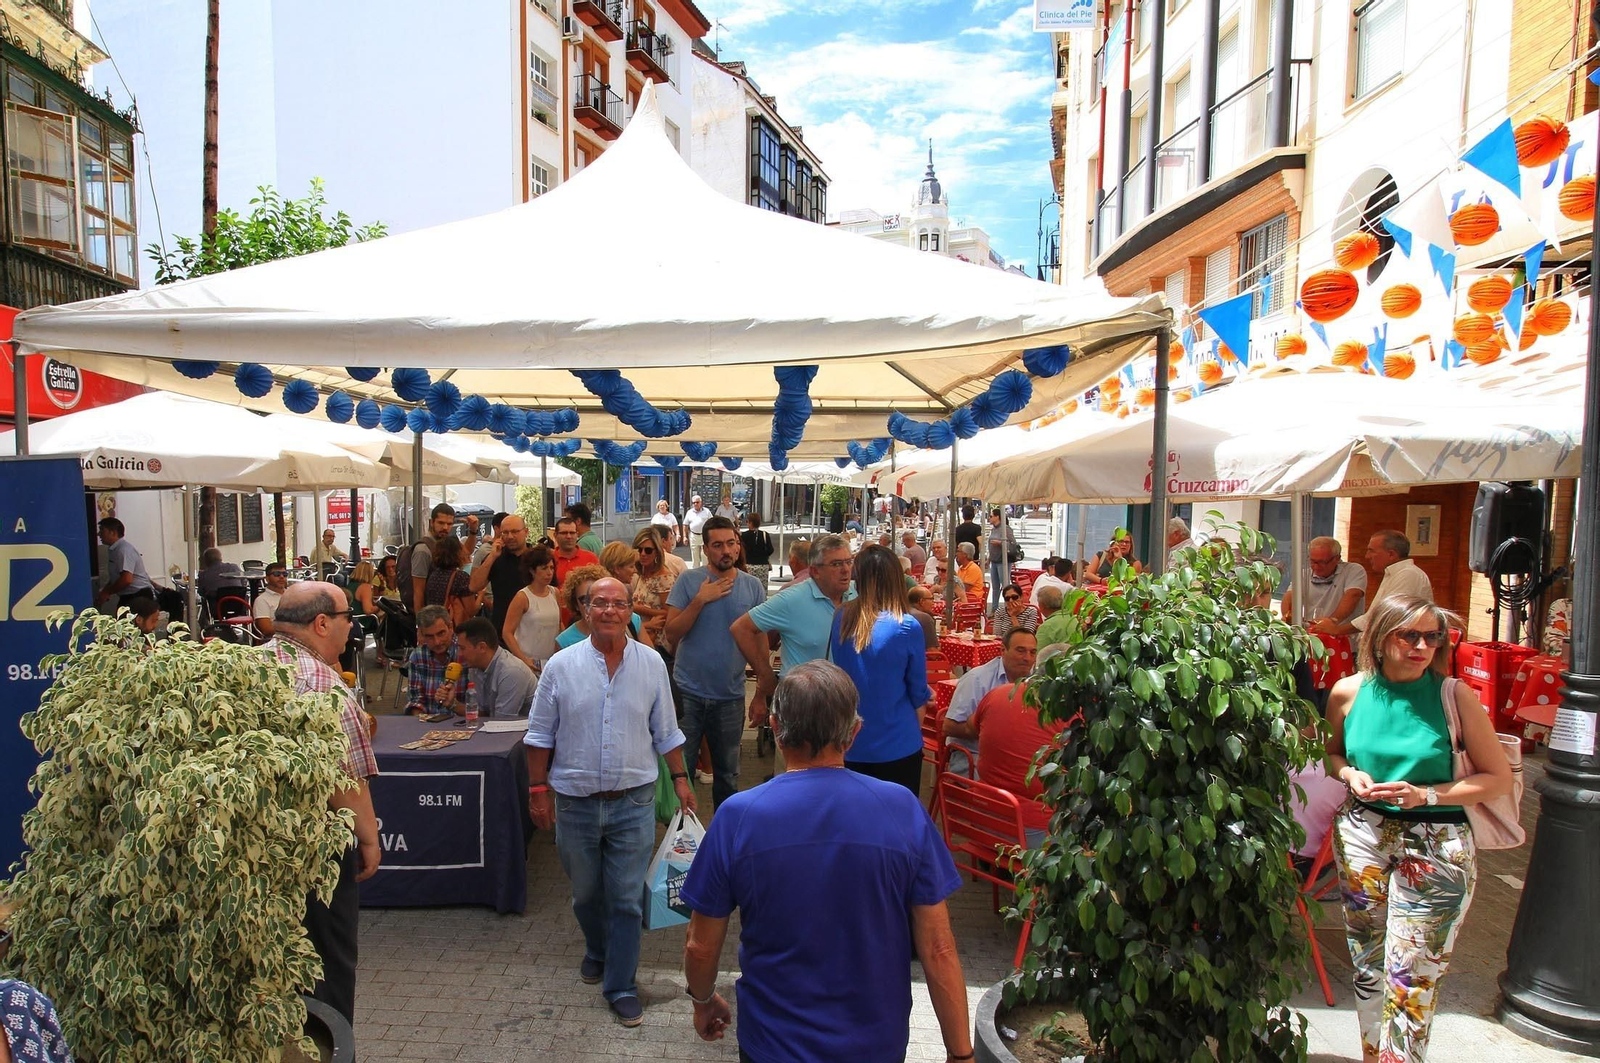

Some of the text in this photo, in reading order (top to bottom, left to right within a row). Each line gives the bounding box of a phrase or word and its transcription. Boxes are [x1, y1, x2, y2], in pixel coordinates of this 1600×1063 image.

[1067, 10, 1079, 18] del
[1081, 10, 1092, 18] Pie
[49, 363, 76, 379] Estrella
[50, 376, 76, 390] Galicia
[96, 455, 144, 471] Galicia
[1167, 475, 1250, 495] Cruzcampo
[418, 794, 463, 807] 98.1 FM
[378, 833, 409, 852] VA
